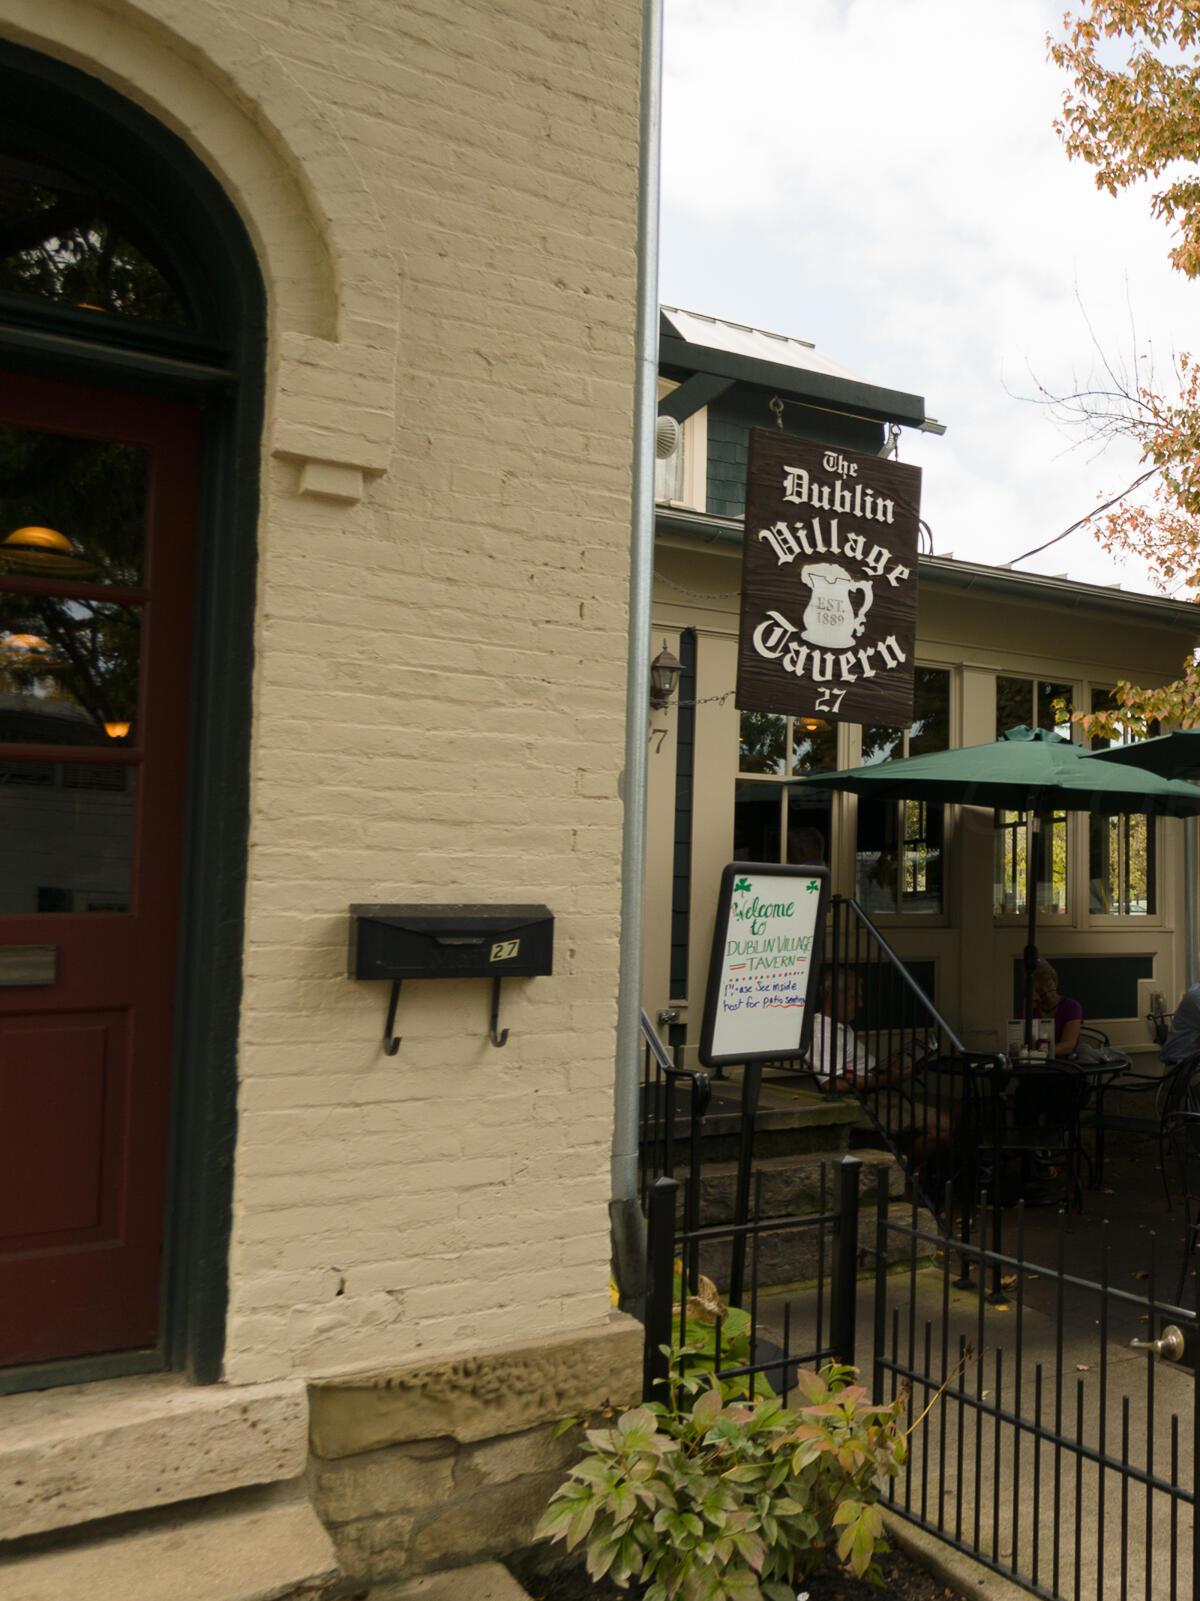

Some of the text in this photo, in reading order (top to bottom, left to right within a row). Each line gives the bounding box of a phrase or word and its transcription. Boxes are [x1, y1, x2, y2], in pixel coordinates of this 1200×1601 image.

[823, 451, 859, 479] The
[783, 465, 896, 525] Dublin
[758, 517, 910, 588] Village
[815, 597, 846, 613] EST.
[816, 612, 846, 626] 1889
[752, 610, 907, 683] Tavern
[815, 687, 847, 713] 27
[732, 896, 795, 922] Welcome
[750, 918, 767, 936] to
[493, 941, 519, 959] 27
[726, 937, 776, 957] DUBLIN
[746, 956, 796, 972] TAVERN
[745, 995, 760, 1009] for
[762, 995, 784, 1009] patio
